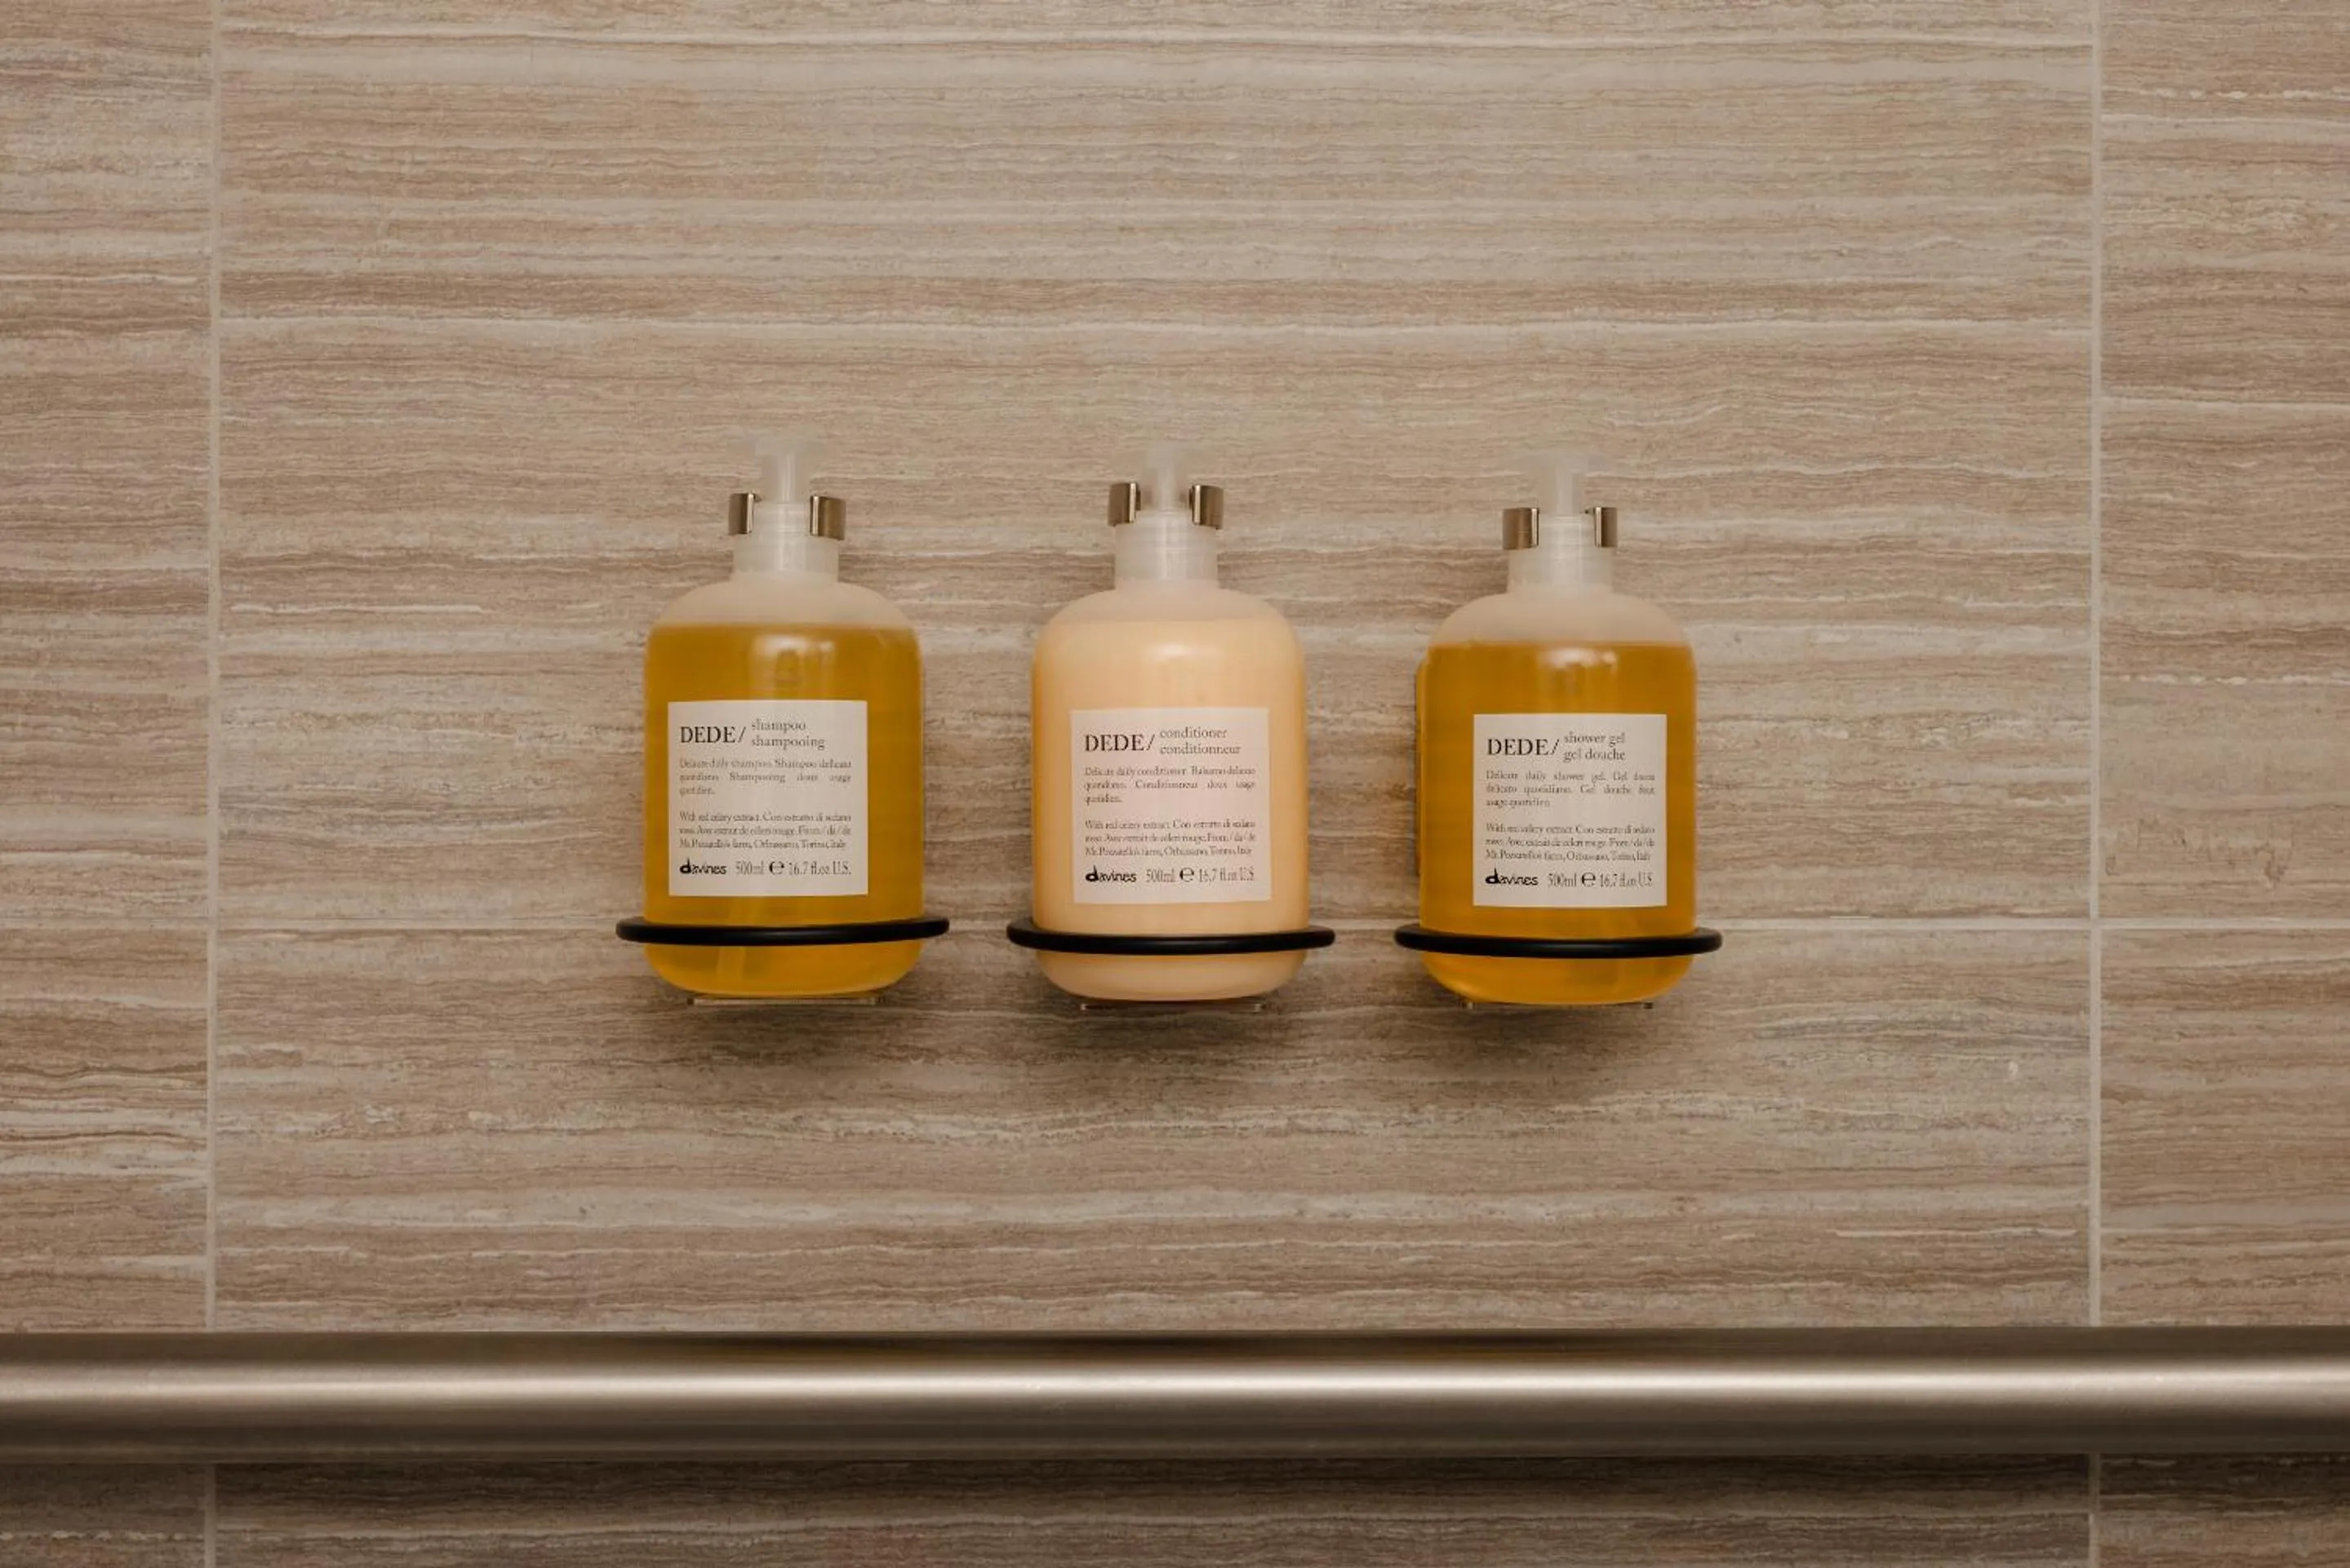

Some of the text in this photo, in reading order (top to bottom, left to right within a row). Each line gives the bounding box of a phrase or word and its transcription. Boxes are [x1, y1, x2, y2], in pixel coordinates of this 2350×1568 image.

[751, 718, 806, 732] shampoo
[1160, 726, 1228, 739] conditioner
[680, 726, 746, 744] DEDE/
[751, 735, 825, 750] shampooing
[1084, 734, 1155, 752] DEDE/
[1563, 731, 1625, 747] shower gel
[1160, 742, 1241, 755] conditionneur
[1487, 738, 1560, 756] DEDE/
[1563, 748, 1626, 763] gel douche
[1085, 865, 1137, 882] davines
[1485, 868, 1539, 886] davines
